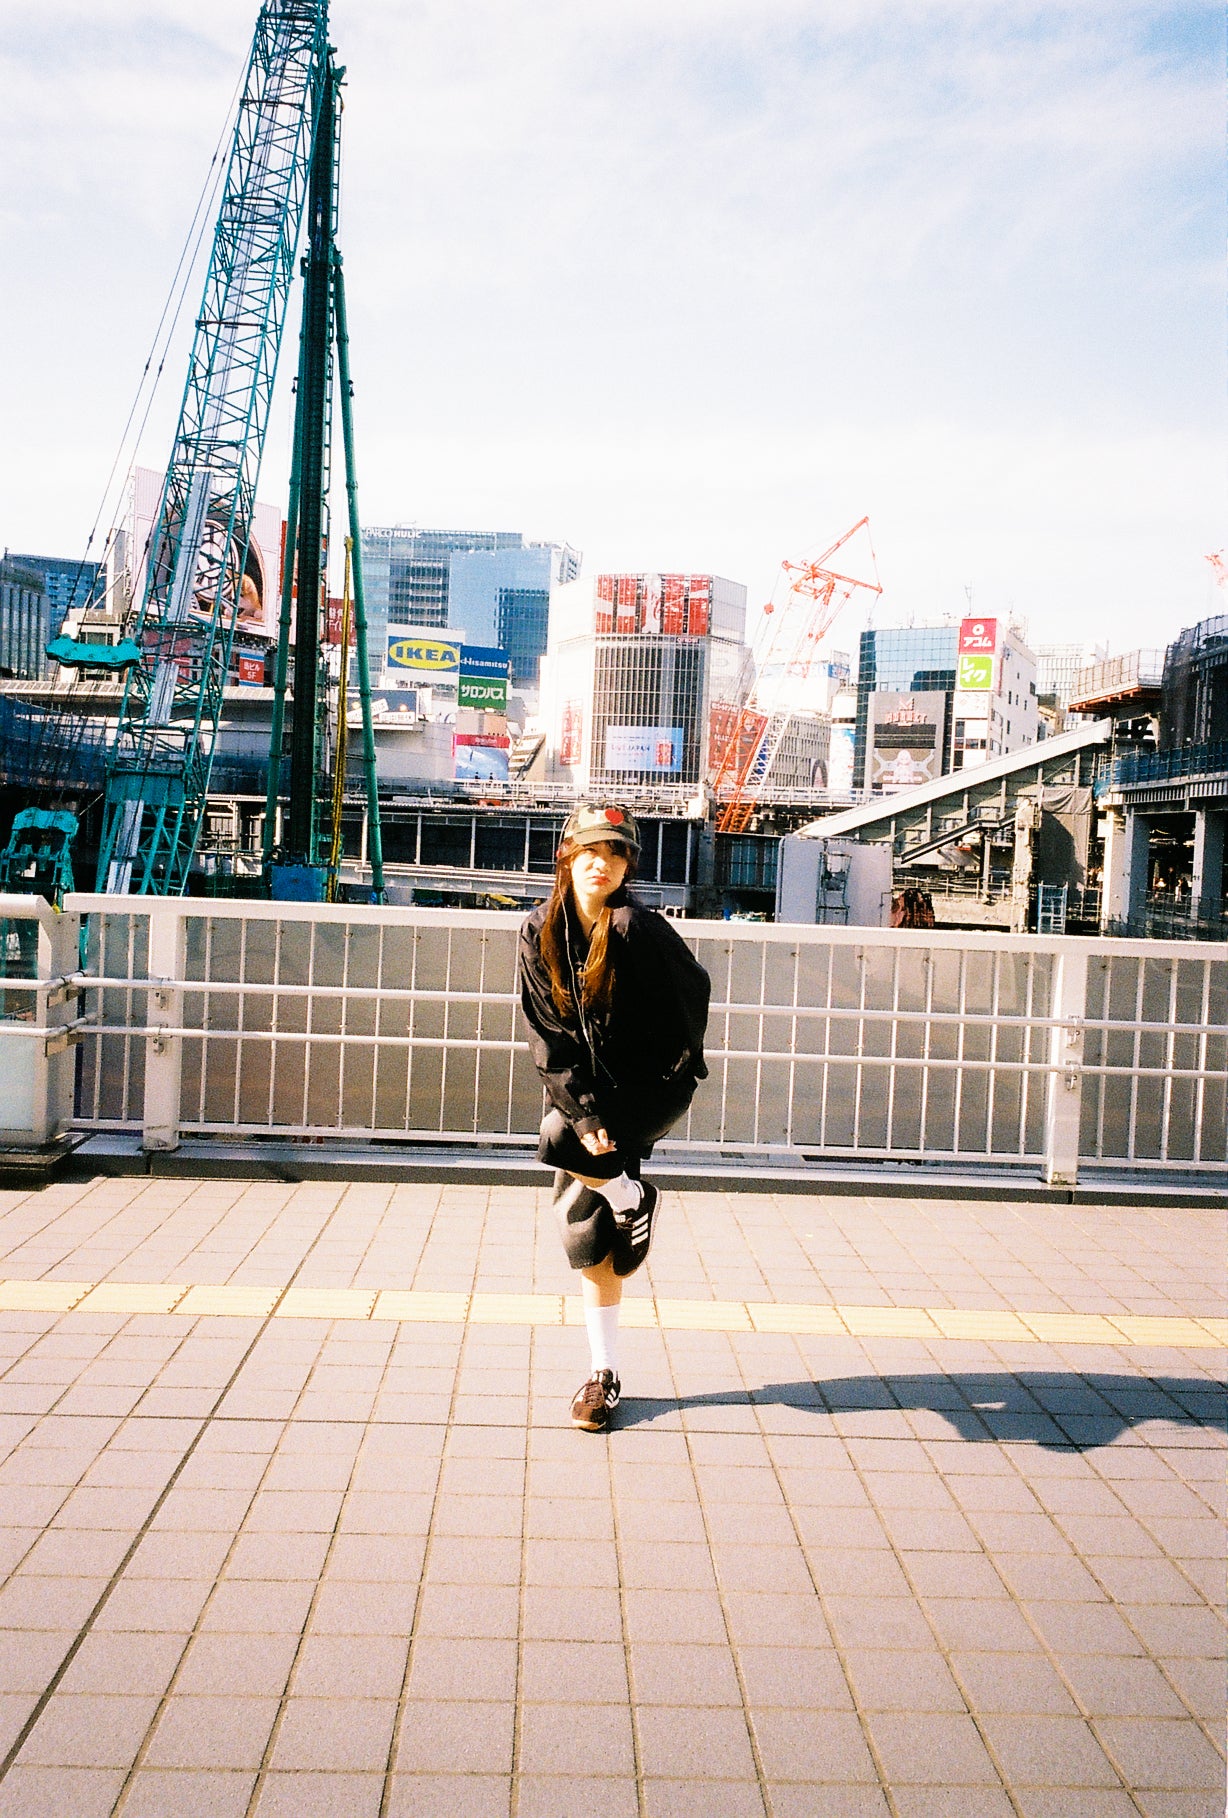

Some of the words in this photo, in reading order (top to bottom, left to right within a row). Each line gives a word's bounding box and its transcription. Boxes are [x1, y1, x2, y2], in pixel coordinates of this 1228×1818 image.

[963, 636, 992, 648] アコム
[395, 646, 456, 663] IKEA
[461, 657, 508, 669] Hisamitsu
[247, 671, 257, 680] 5F
[461, 684, 505, 700] サロンパス
